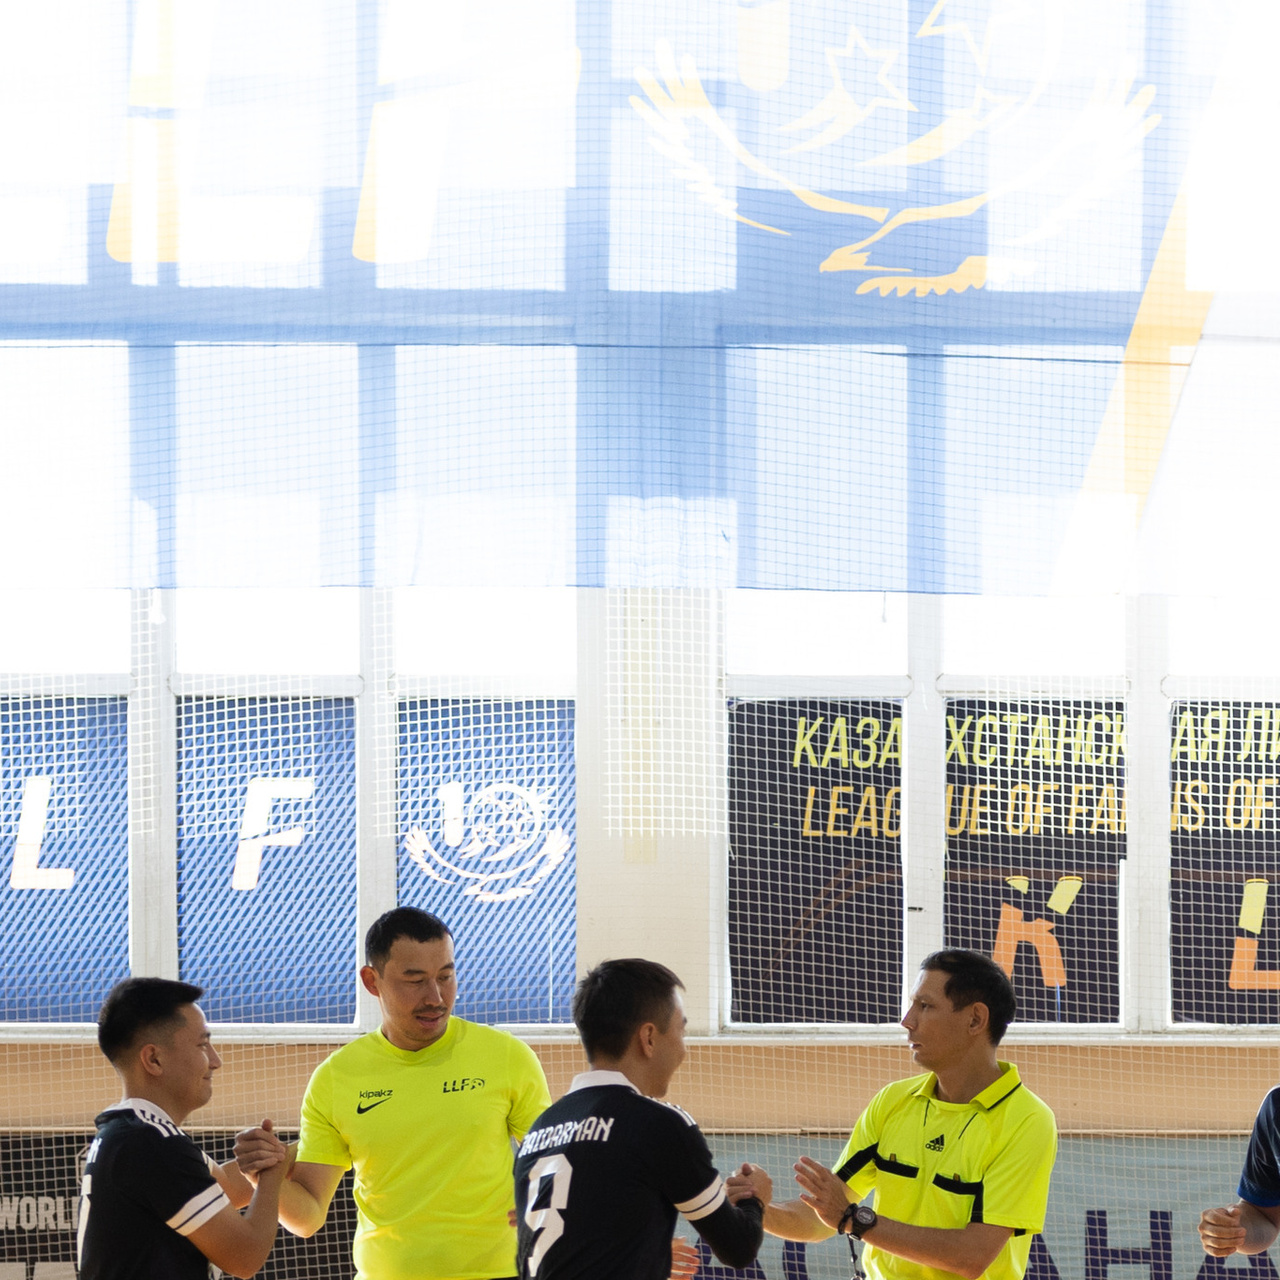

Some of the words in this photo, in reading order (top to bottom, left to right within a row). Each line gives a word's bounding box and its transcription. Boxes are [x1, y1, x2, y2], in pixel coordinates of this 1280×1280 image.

[802, 783, 997, 838] LEAGUE
[1005, 783, 1060, 836] OF
[1225, 778, 1279, 831] OF
[524, 1153, 573, 1278] 9
